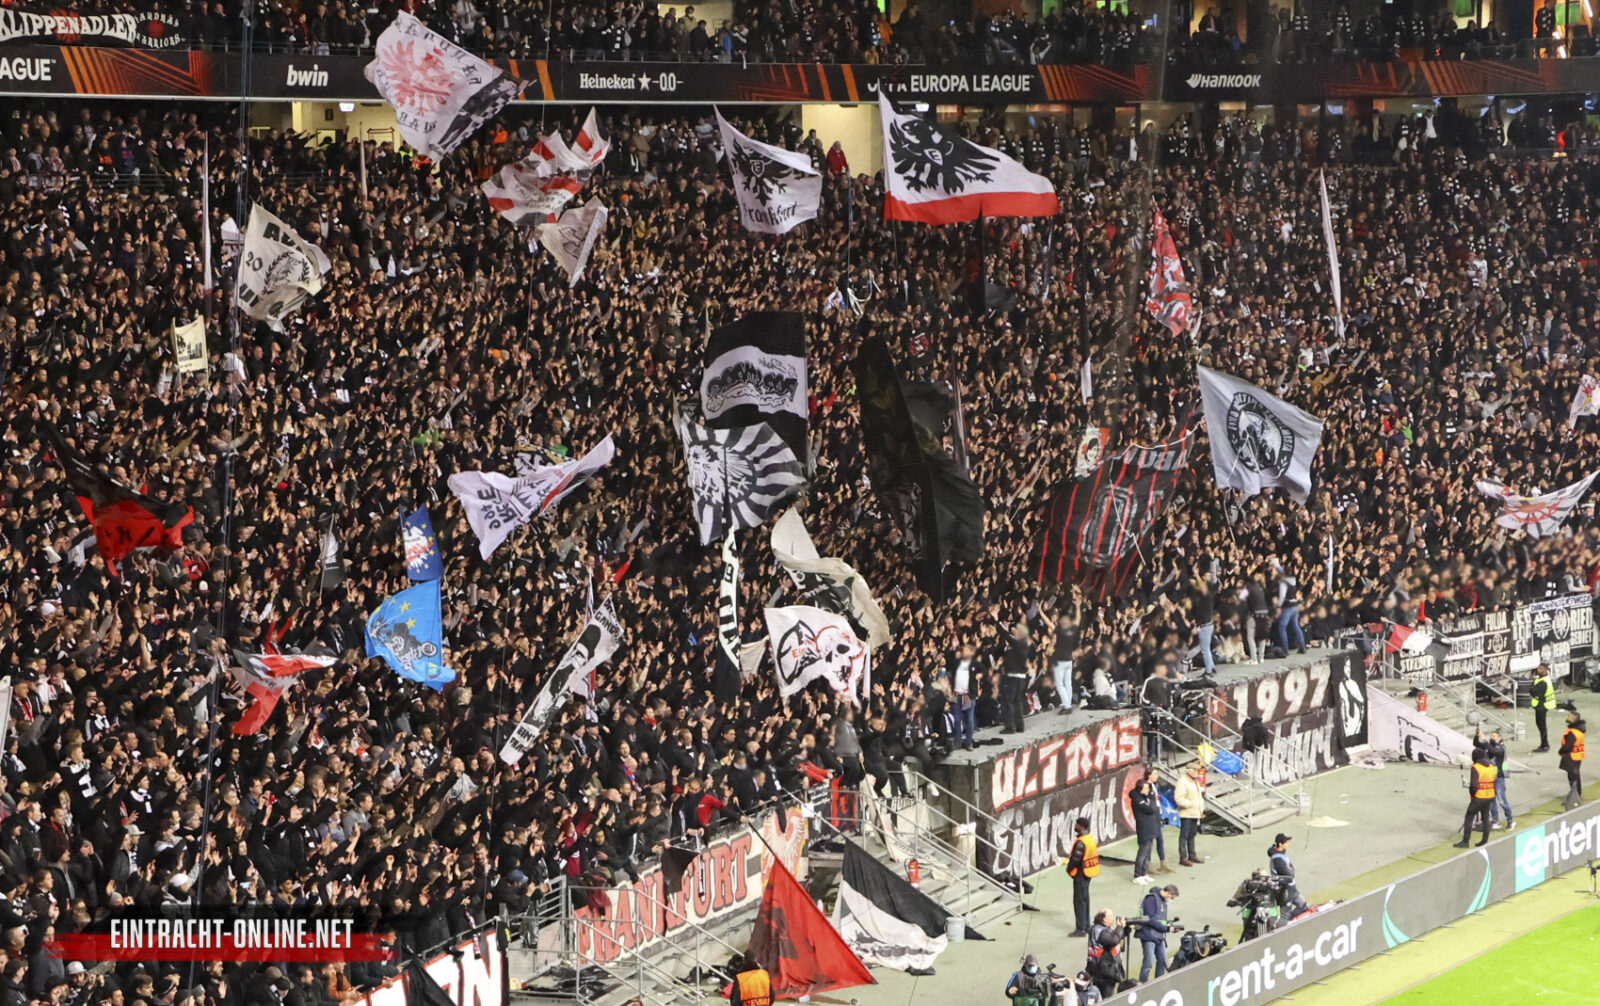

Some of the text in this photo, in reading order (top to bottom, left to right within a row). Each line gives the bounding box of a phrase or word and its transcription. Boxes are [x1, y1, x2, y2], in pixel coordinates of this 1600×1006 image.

[286, 65, 329, 87] bwin
[580, 73, 636, 89] Heineken
[911, 75, 969, 92] EUROPA
[973, 75, 1031, 92] LEAGUE
[1233, 658, 1331, 731] 1997
[992, 712, 1142, 812] ULTRAS
[1208, 916, 1363, 1006] rent-a-car
